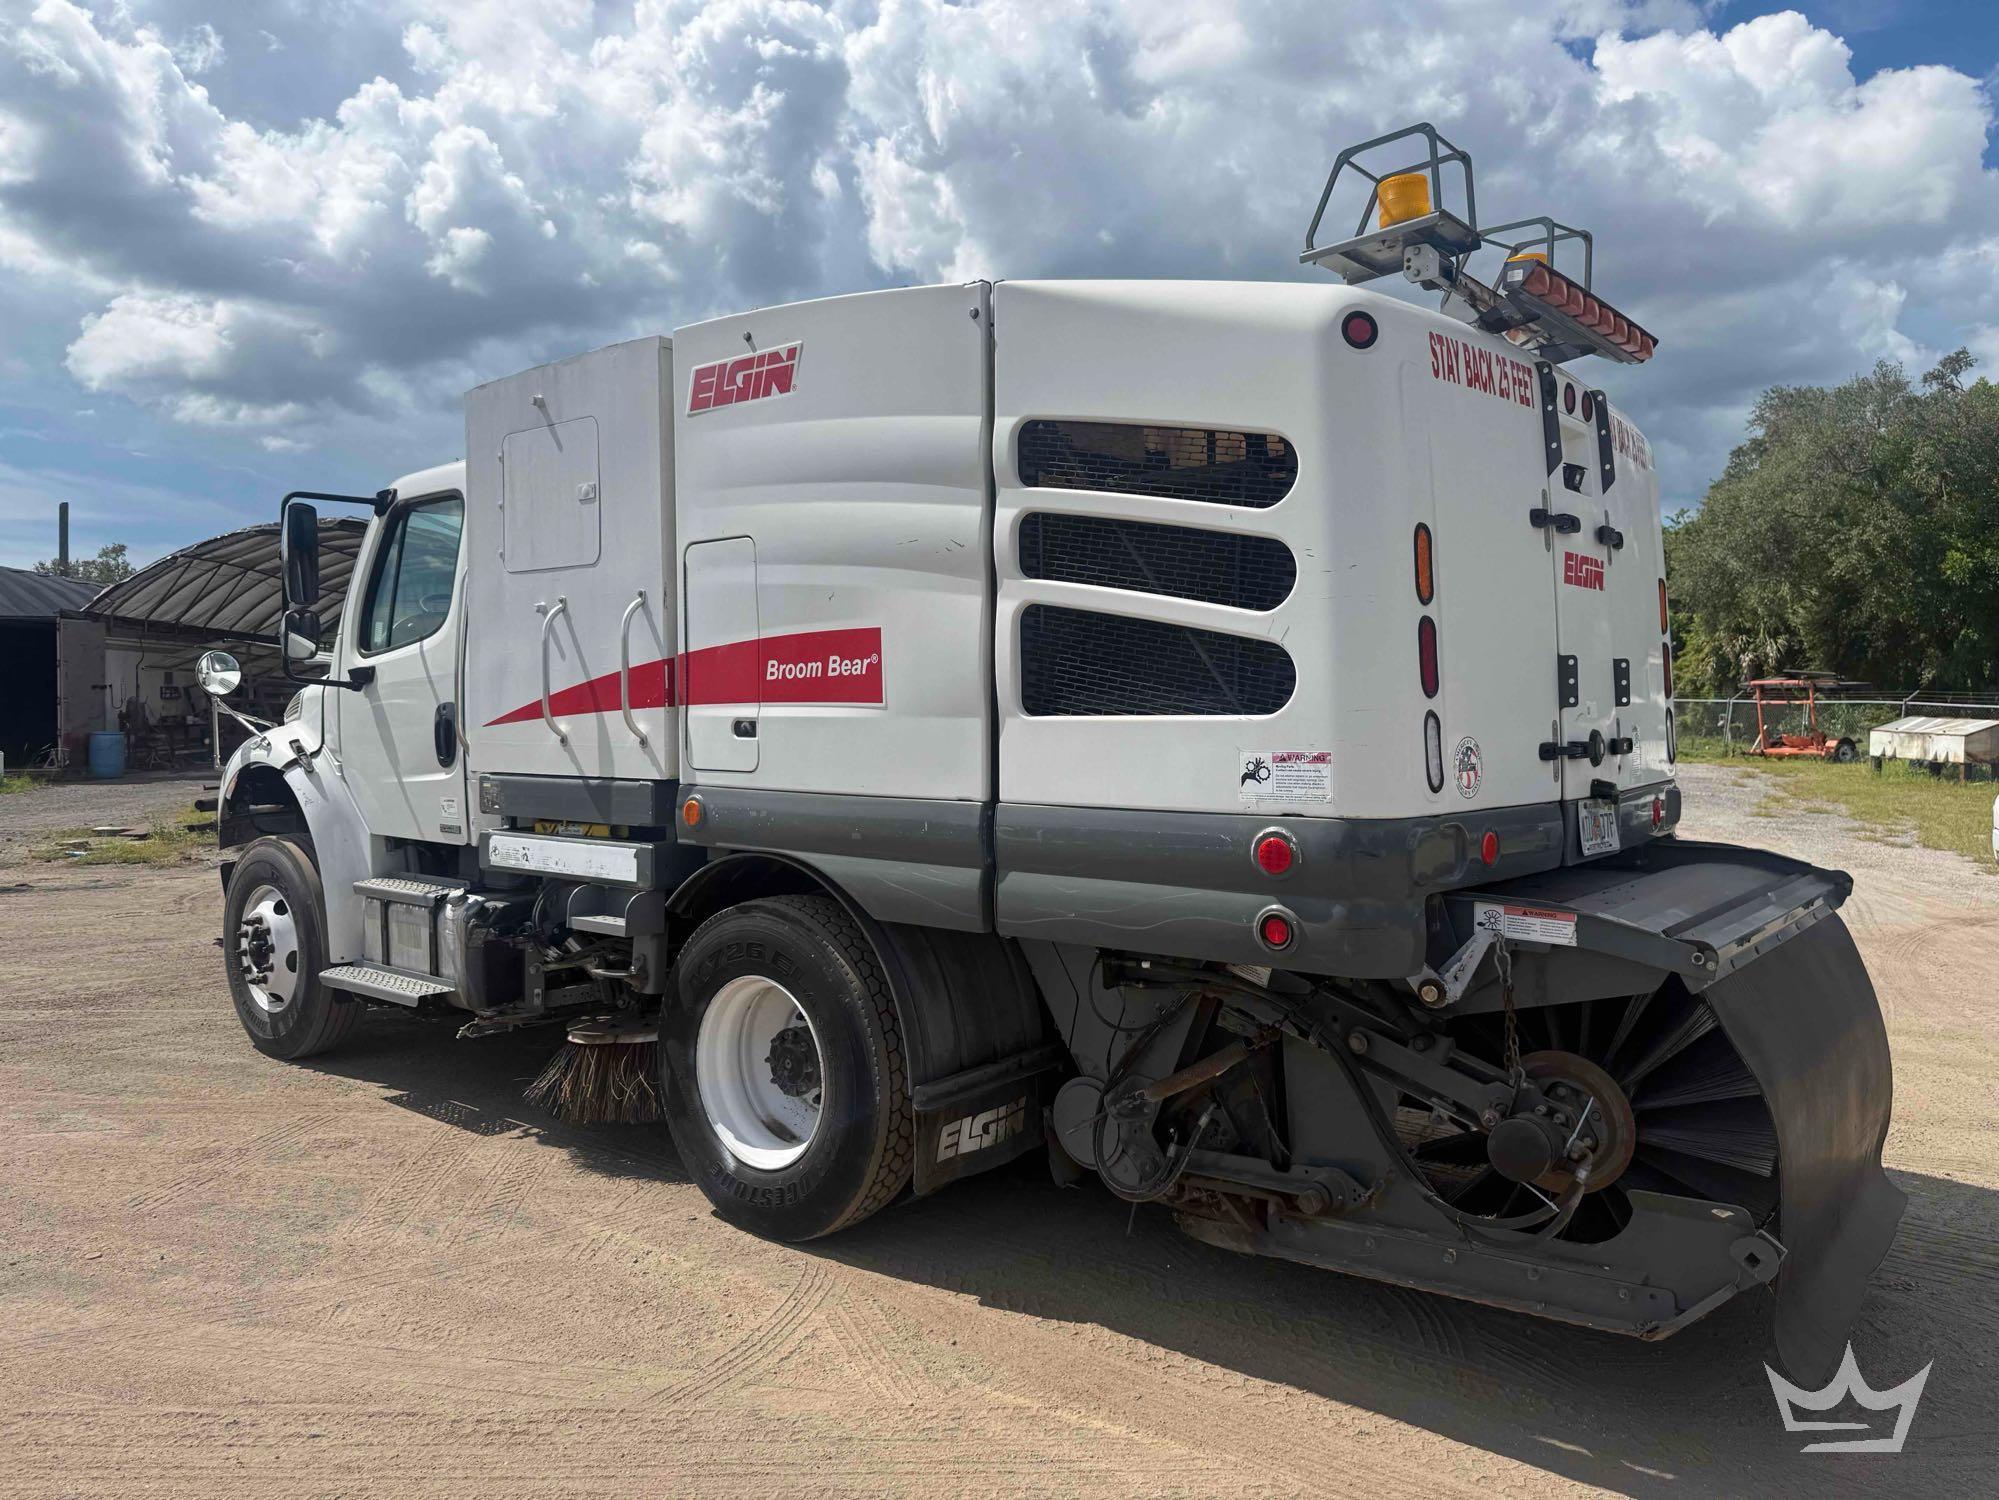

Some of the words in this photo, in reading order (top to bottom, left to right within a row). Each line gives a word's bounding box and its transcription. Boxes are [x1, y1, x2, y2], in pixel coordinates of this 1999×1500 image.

[1429, 331, 1460, 385] STAY
[1462, 342, 1496, 395] BACK
[1496, 354, 1510, 400] 25
[1510, 360, 1535, 409] FEET
[1564, 551, 1605, 592] ELGIN
[766, 660, 822, 681] Broom
[1287, 753, 1326, 762] WARNING
[1528, 910, 1557, 919] WARNING
[936, 1096, 1027, 1164] ELGIN
